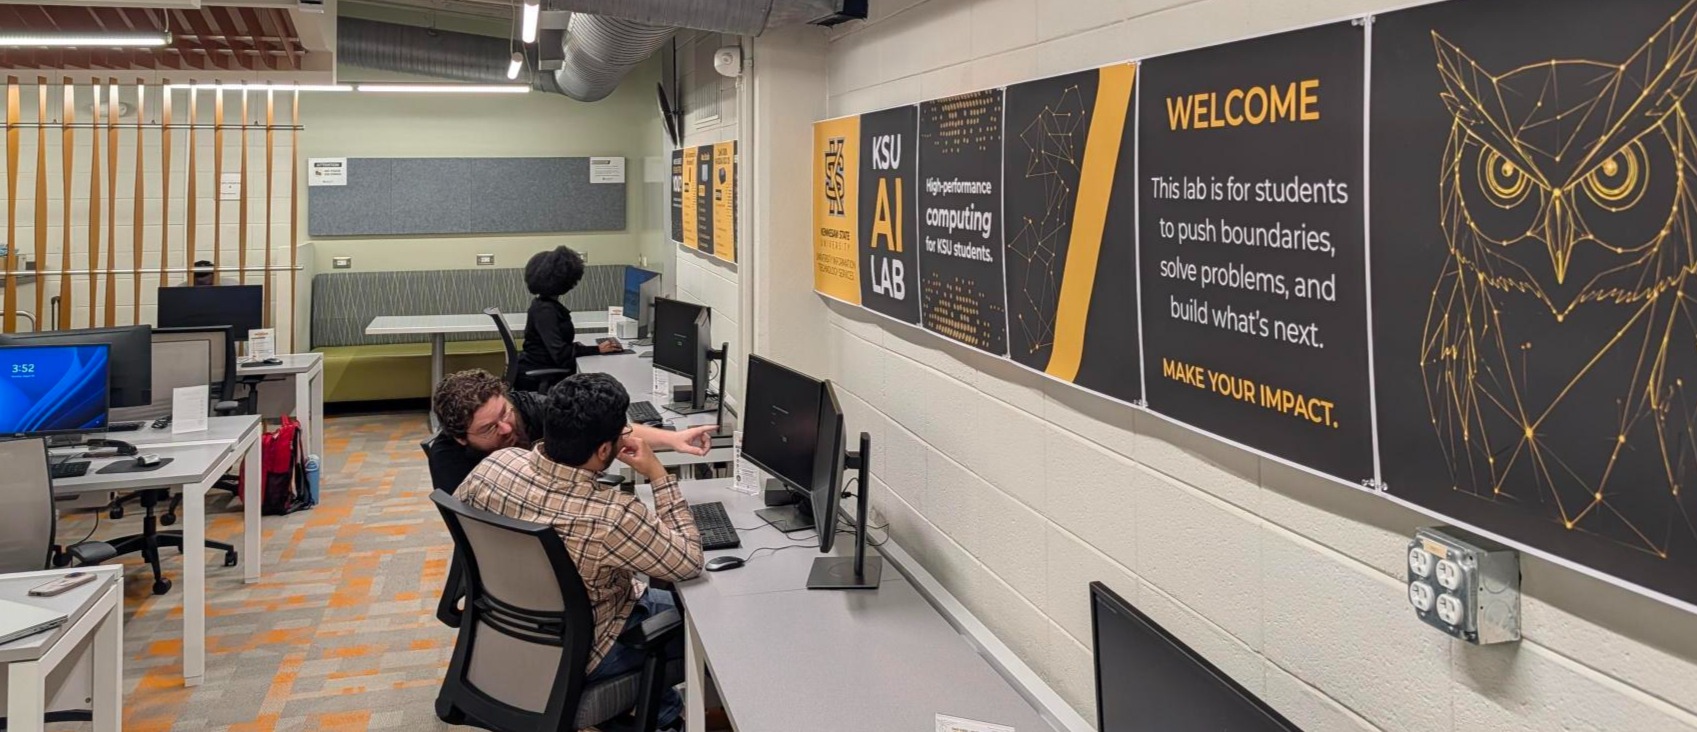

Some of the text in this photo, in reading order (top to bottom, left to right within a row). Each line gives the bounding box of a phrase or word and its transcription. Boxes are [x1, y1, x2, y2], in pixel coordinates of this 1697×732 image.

[1166, 79, 1320, 131] WELCOME
[872, 134, 901, 170] KSU
[926, 178, 992, 196] High-performance
[1151, 175, 1349, 204] This lab is for students
[870, 177, 903, 252] AI
[926, 203, 992, 239] computing
[925, 236, 993, 263] for KSU students.
[1159, 218, 1336, 257] to push boundaries,
[871, 254, 905, 300] LAB
[1160, 256, 1336, 302] solve problems, and
[1170, 295, 1208, 325] build
[1274, 321, 1324, 349] next.
[12, 363, 35, 373] 3:52
[1162, 357, 1339, 429] MAKE YOUR IMPACT.
